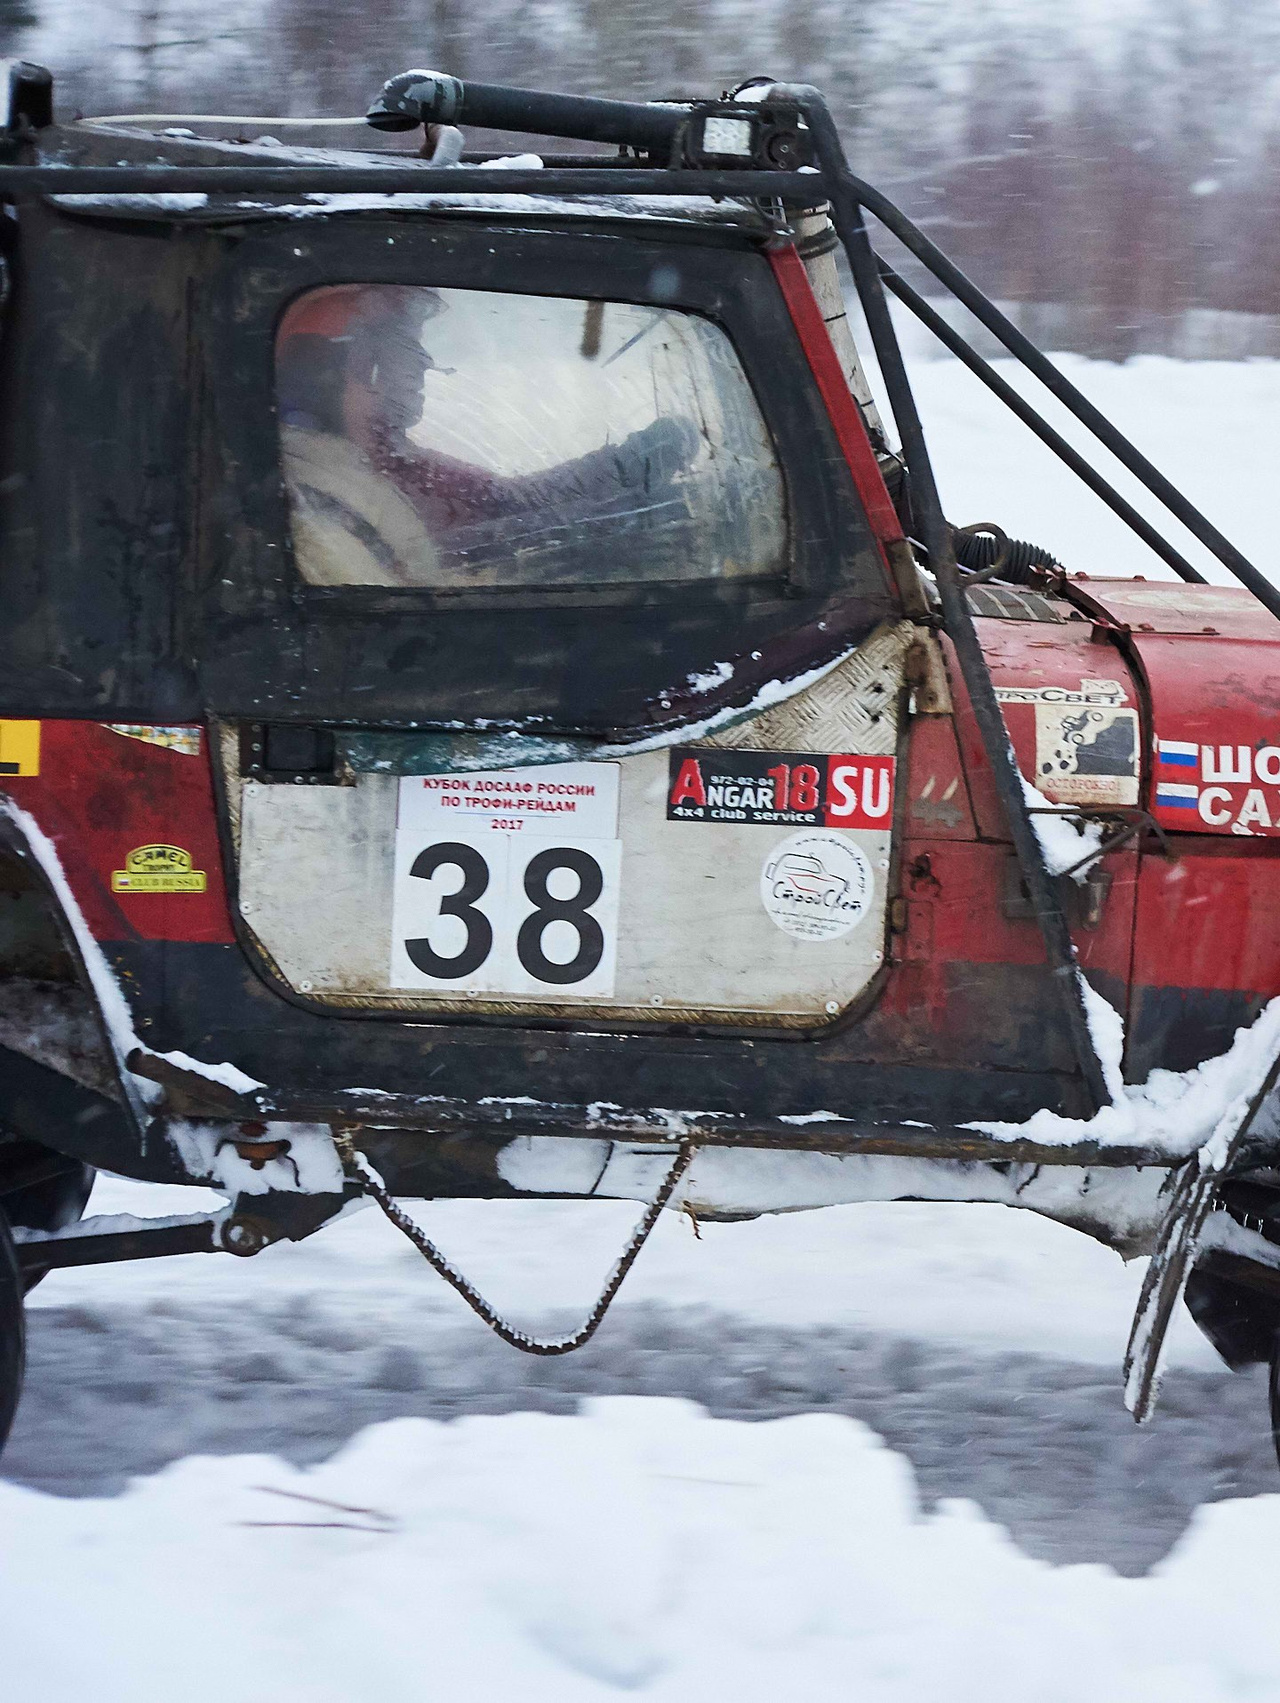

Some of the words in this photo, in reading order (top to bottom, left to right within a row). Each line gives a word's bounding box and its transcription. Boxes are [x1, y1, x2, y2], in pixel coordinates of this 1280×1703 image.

[423, 778, 471, 791] КУБОК
[474, 780, 532, 794] ДОСААФ
[537, 783, 596, 796] РОССИИ
[441, 796, 460, 807] ПО
[465, 797, 576, 813] ТРОФИ-РЕЙДАМ
[672, 807, 704, 818] 4x4
[711, 807, 747, 820] club
[753, 811, 816, 823] service
[491, 819, 524, 830] 2017
[404, 842, 604, 985] 38
